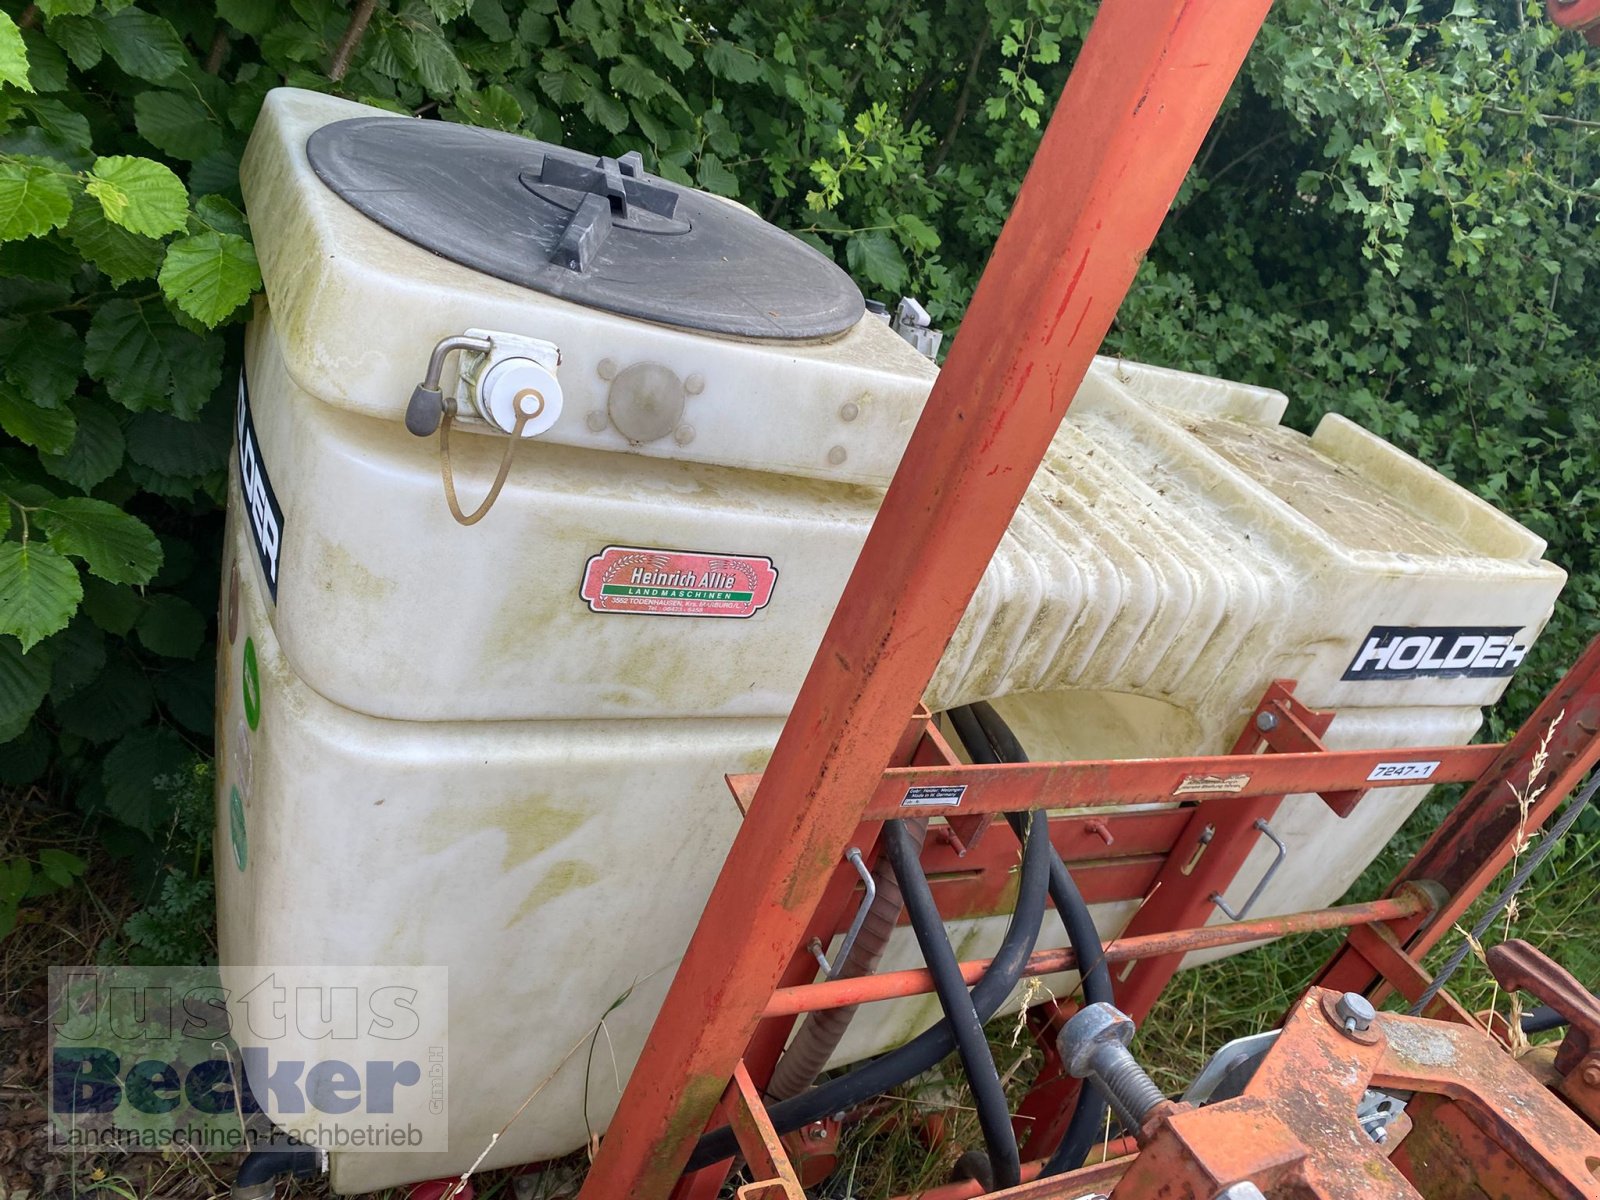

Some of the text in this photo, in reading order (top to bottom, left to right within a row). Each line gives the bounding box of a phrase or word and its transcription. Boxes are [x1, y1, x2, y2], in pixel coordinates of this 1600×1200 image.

[631, 567, 696, 587] Heinrich
[629, 589, 732, 599] LANDMASCHINEN
[1351, 635, 1528, 672] HOLDER
[1374, 765, 1431, 777] 7247-1
